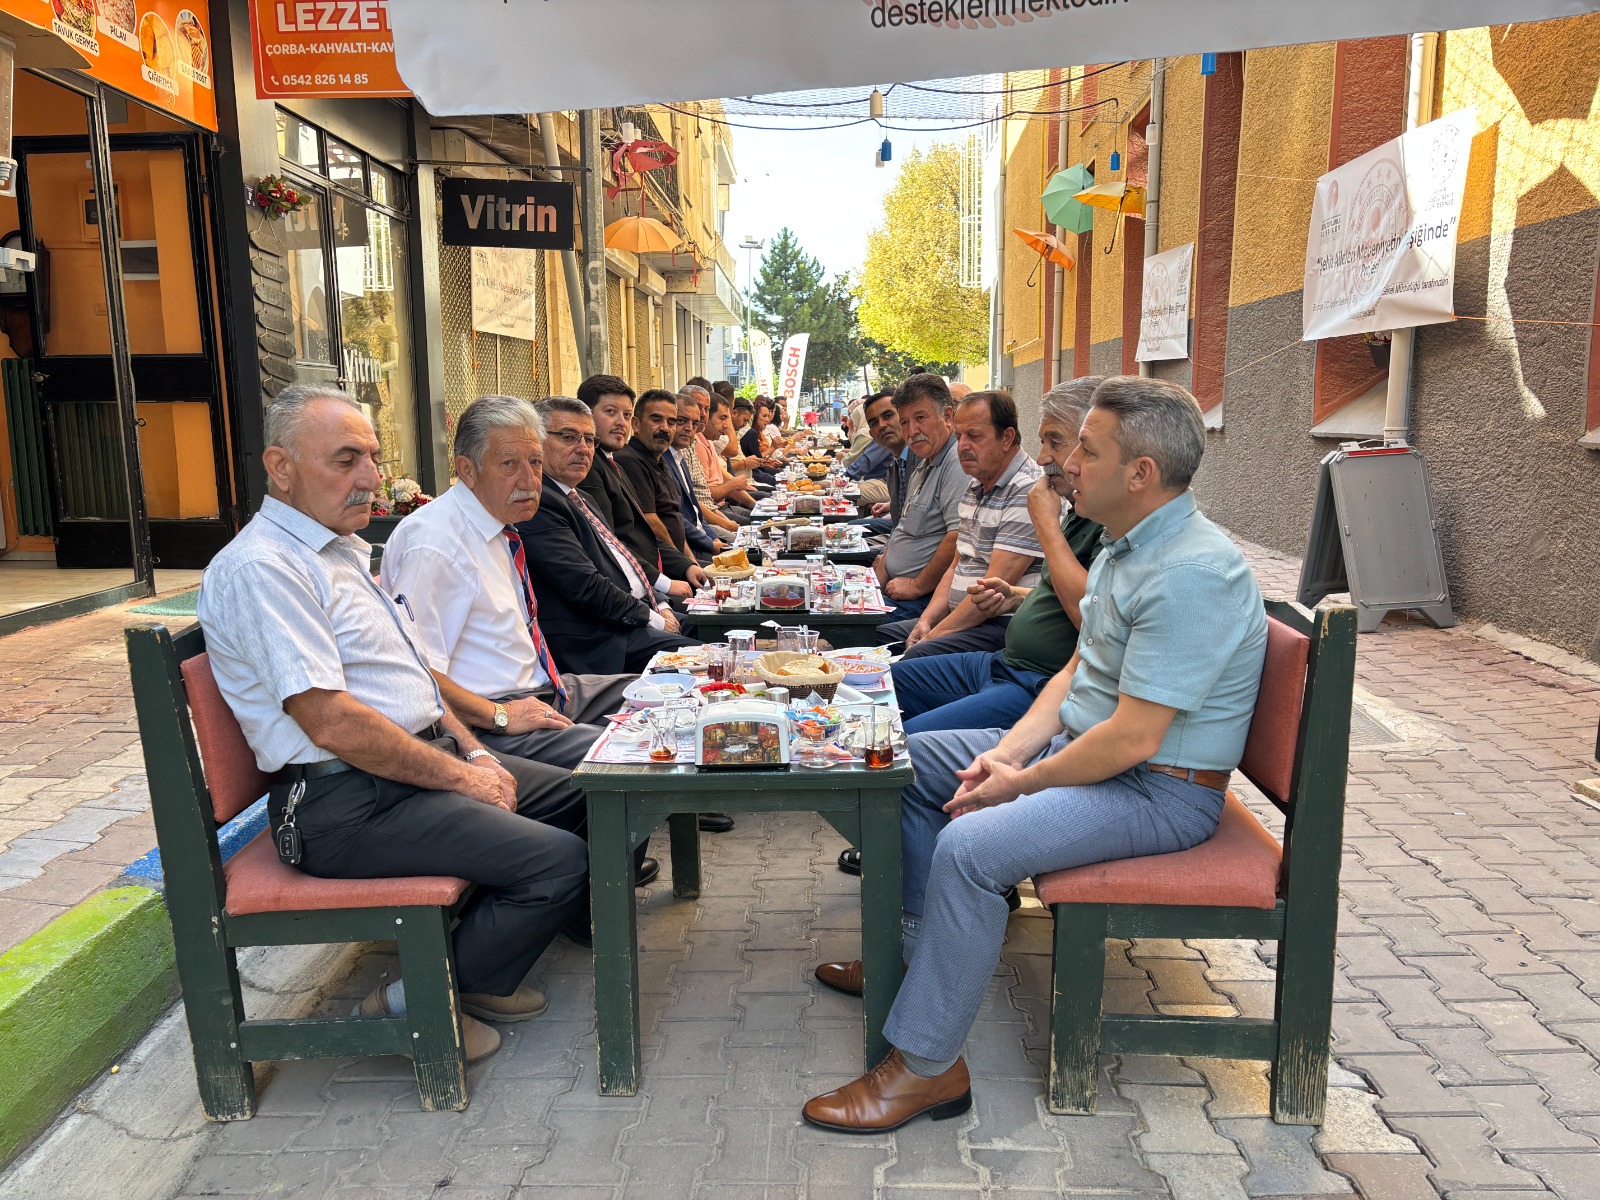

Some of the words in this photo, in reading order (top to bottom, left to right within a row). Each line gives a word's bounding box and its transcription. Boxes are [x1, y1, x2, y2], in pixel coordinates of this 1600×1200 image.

[53, 22, 74, 41] TAVUK
[282, 74, 312, 85] 0542
[314, 74, 336, 85] 826
[339, 74, 351, 84] 14
[354, 73, 369, 84] 85
[460, 194, 557, 233] Vitrin
[343, 348, 383, 384] Vitrin
[784, 346, 801, 399] BOSCH
